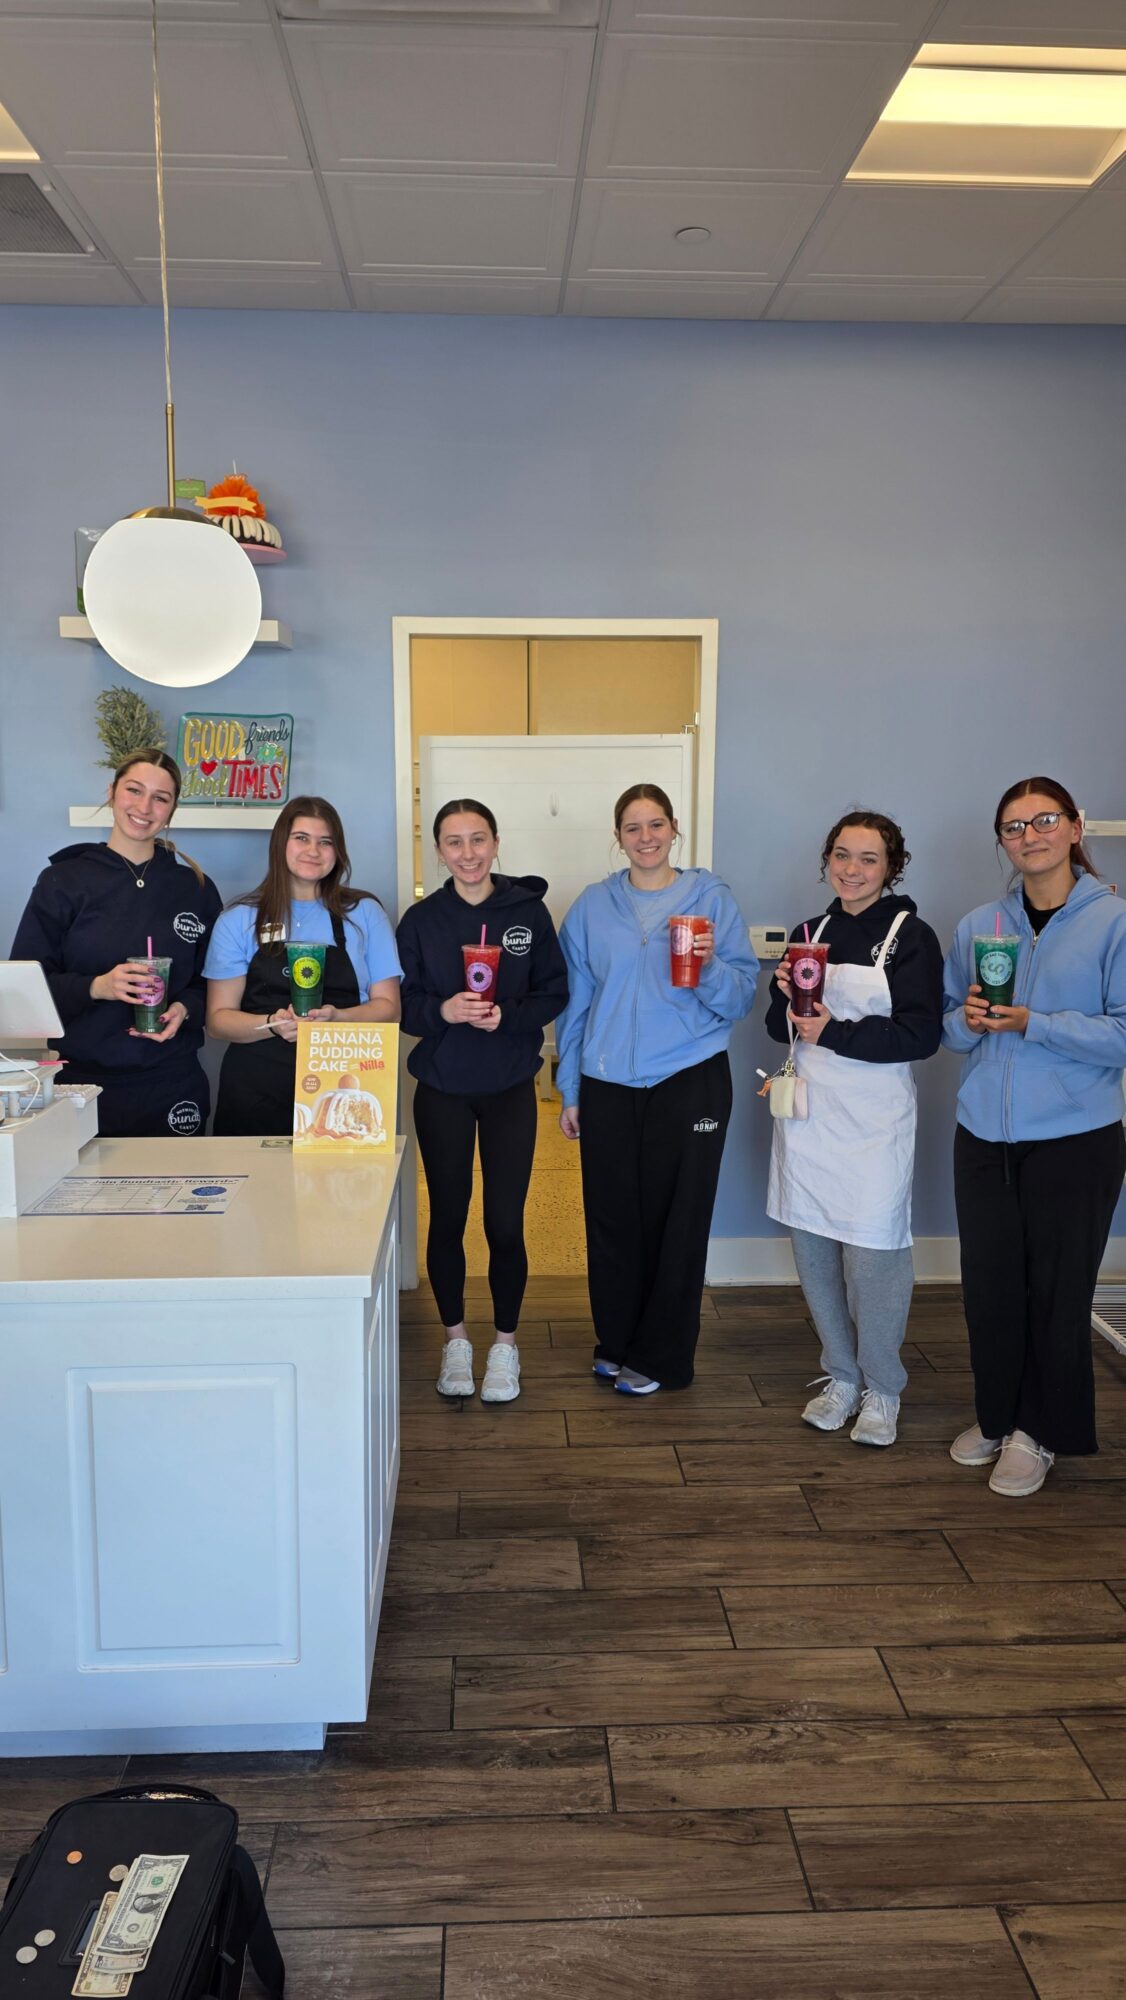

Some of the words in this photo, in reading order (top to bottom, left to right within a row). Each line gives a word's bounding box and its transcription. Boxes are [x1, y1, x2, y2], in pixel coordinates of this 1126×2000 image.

[184, 718, 246, 767] GOOD
[245, 719, 289, 756] friends
[310, 1031, 383, 1045] BANANA
[309, 1046, 383, 1060] PUDDING
[308, 1060, 348, 1072] CAKE
[359, 1060, 385, 1071] Nilla
